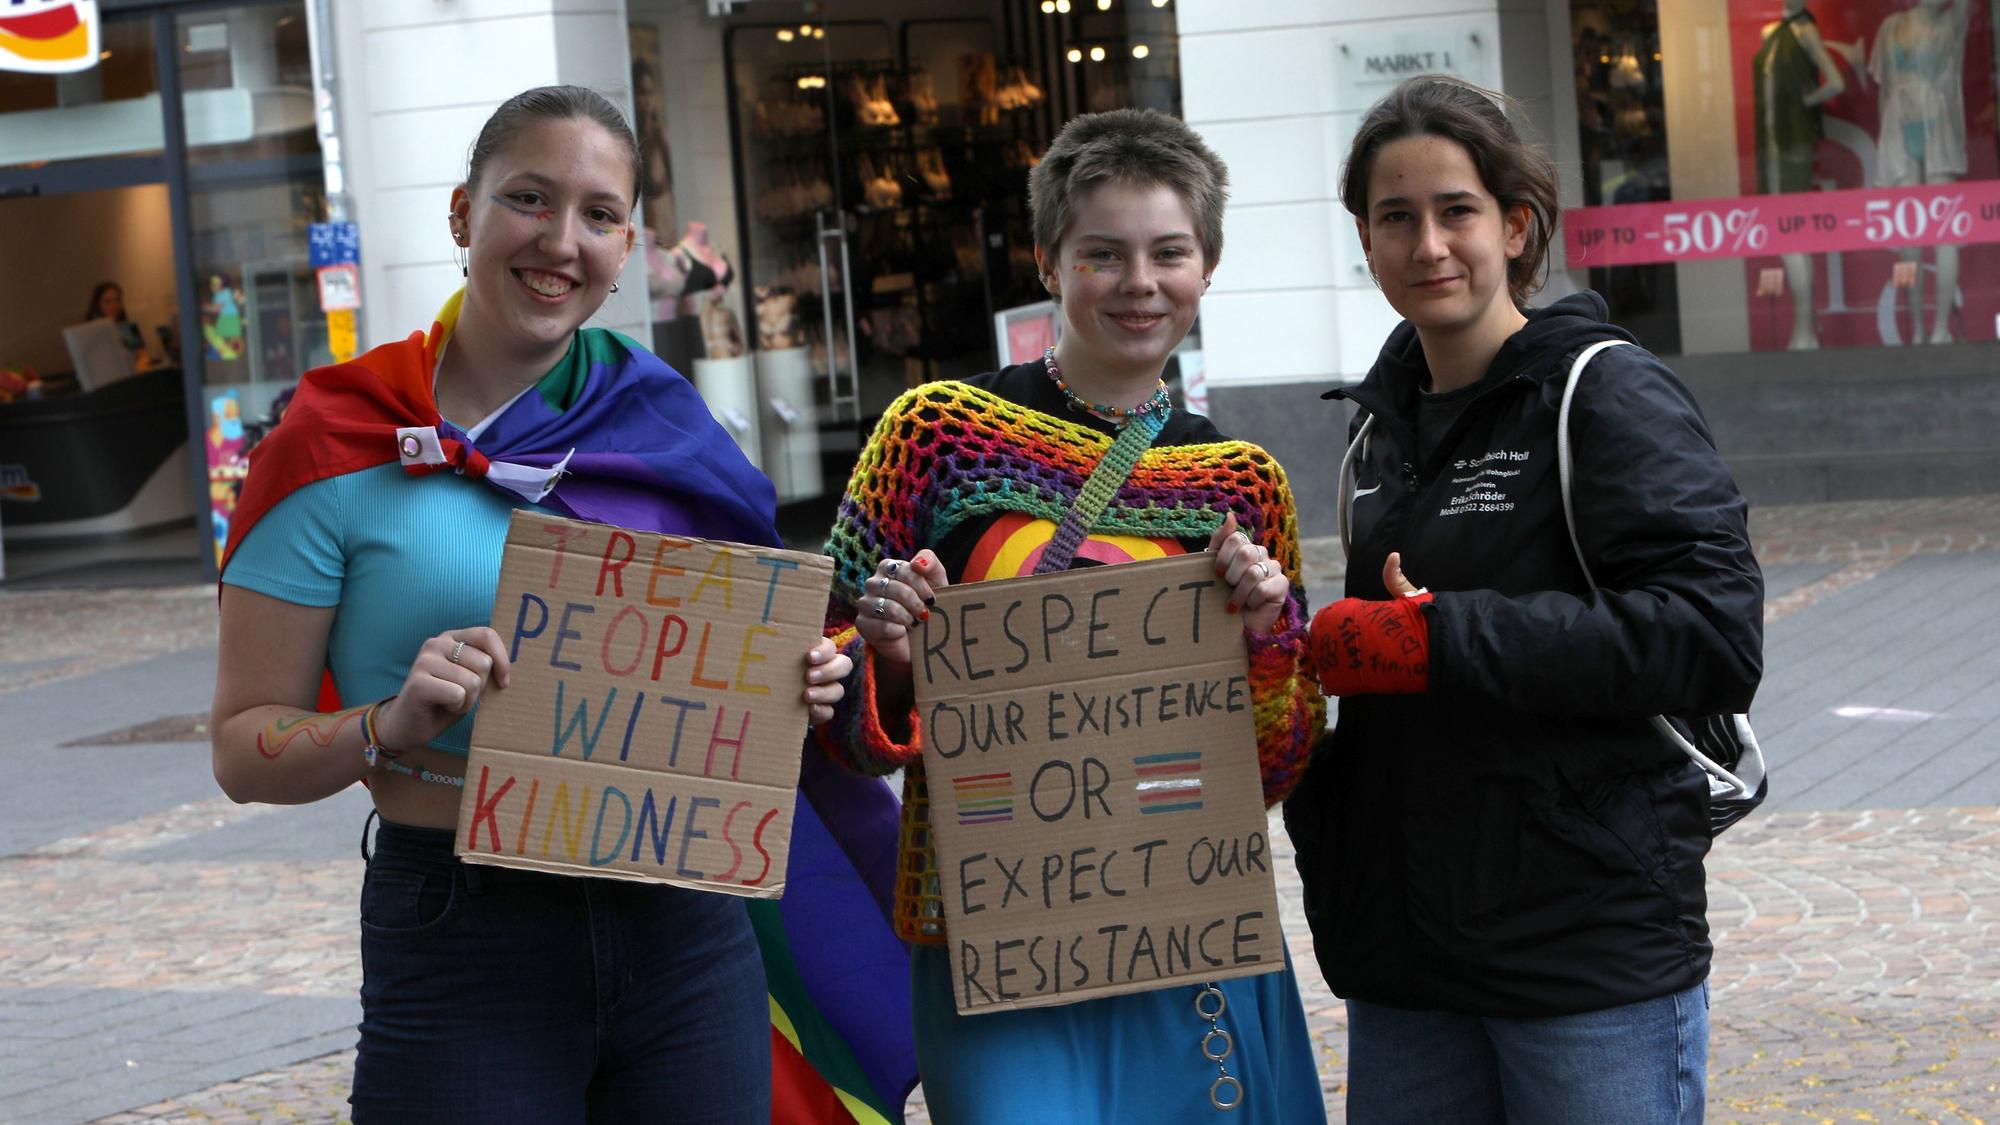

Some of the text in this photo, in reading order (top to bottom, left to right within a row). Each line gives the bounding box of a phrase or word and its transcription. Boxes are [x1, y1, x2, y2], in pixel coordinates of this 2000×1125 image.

[1365, 51, 1452, 74] MARKT 1
[1577, 228, 1606, 247] UP
[1612, 226, 1636, 245] TO
[1643, 207, 1769, 255] -50%
[1778, 215, 1806, 234] UP
[1811, 213, 1837, 232] TO
[1845, 193, 1973, 243] -50%
[1509, 450, 1530, 462] Hall
[1478, 502, 1515, 512] 2684399
[543, 524, 798, 624] TREAT
[510, 592, 778, 695] PEOPLE
[923, 580, 1215, 683] RESPECT
[552, 680, 751, 780] WITH
[930, 675, 1247, 758] OUR EXISTENCE
[468, 765, 779, 886] KINDNESS
[1029, 756, 1113, 822] OR
[959, 831, 1268, 916] EXPECT OUR
[961, 911, 1265, 1008] RESISTANCE
